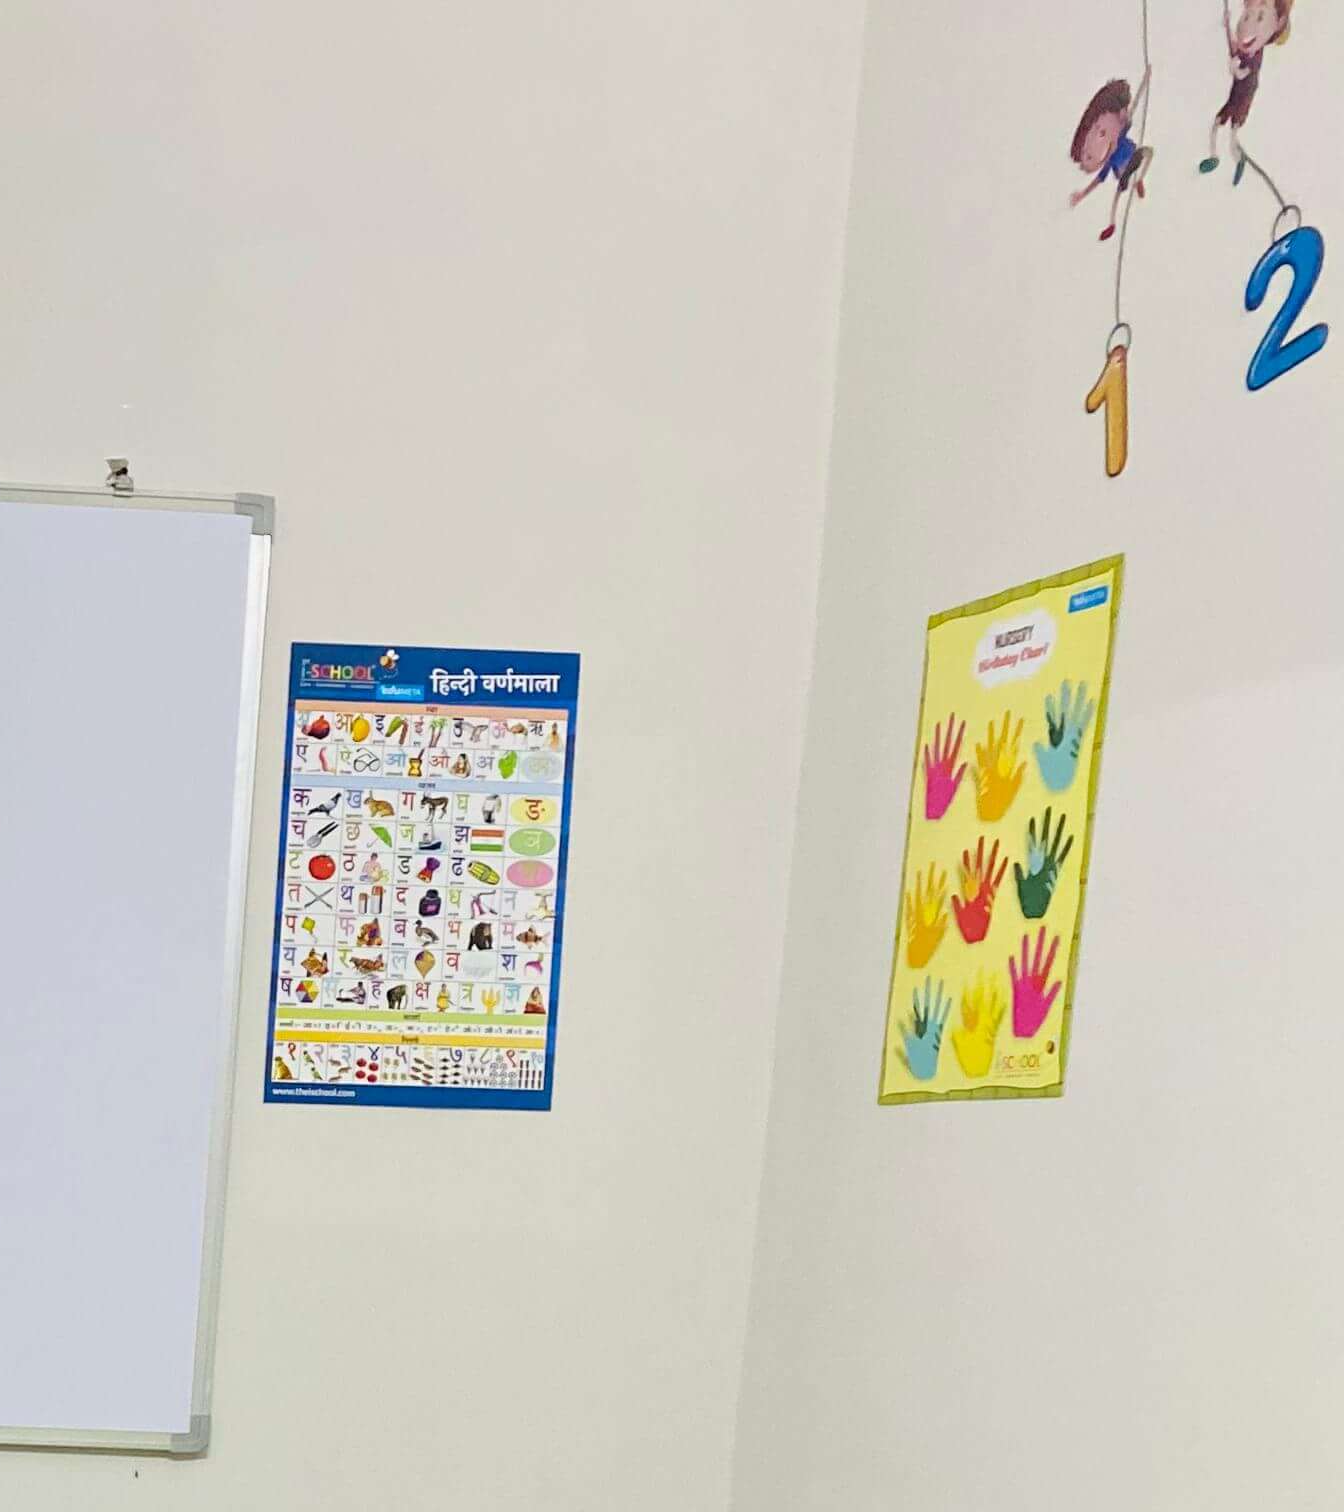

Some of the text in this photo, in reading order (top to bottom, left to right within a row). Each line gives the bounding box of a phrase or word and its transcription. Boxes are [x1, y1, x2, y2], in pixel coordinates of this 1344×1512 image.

[1244, 226, 1328, 392] 2
[1085, 344, 1130, 477] 1
[1020, 640, 1051, 661] Chart
[429, 668, 561, 696] हिन्दी वर्णमाला
[374, 714, 386, 735] इ
[452, 717, 464, 738] उ
[296, 744, 309, 763] ए
[292, 788, 313, 808] क
[346, 789, 364, 809] ख
[401, 791, 417, 812] ग
[291, 819, 307, 840] च
[345, 821, 362, 841] छ
[399, 823, 416, 843] ज
[288, 850, 466, 877] ट ठ ड ढ
[288, 883, 302, 903] त
[340, 885, 355, 905] थ
[395, 887, 409, 906] द
[503, 890, 519, 911] न
[285, 915, 517, 941] प फ ब भ म
[282, 947, 519, 973] य र ल व श
[280, 977, 293, 998] ष
[370, 980, 385, 1000] ह
[415, 981, 432, 1001] क्ष
[287, 1042, 297, 1061] १
[367, 1046, 381, 1062] ४
[449, 1047, 463, 1063] ७
[505, 1049, 517, 1068] ९
